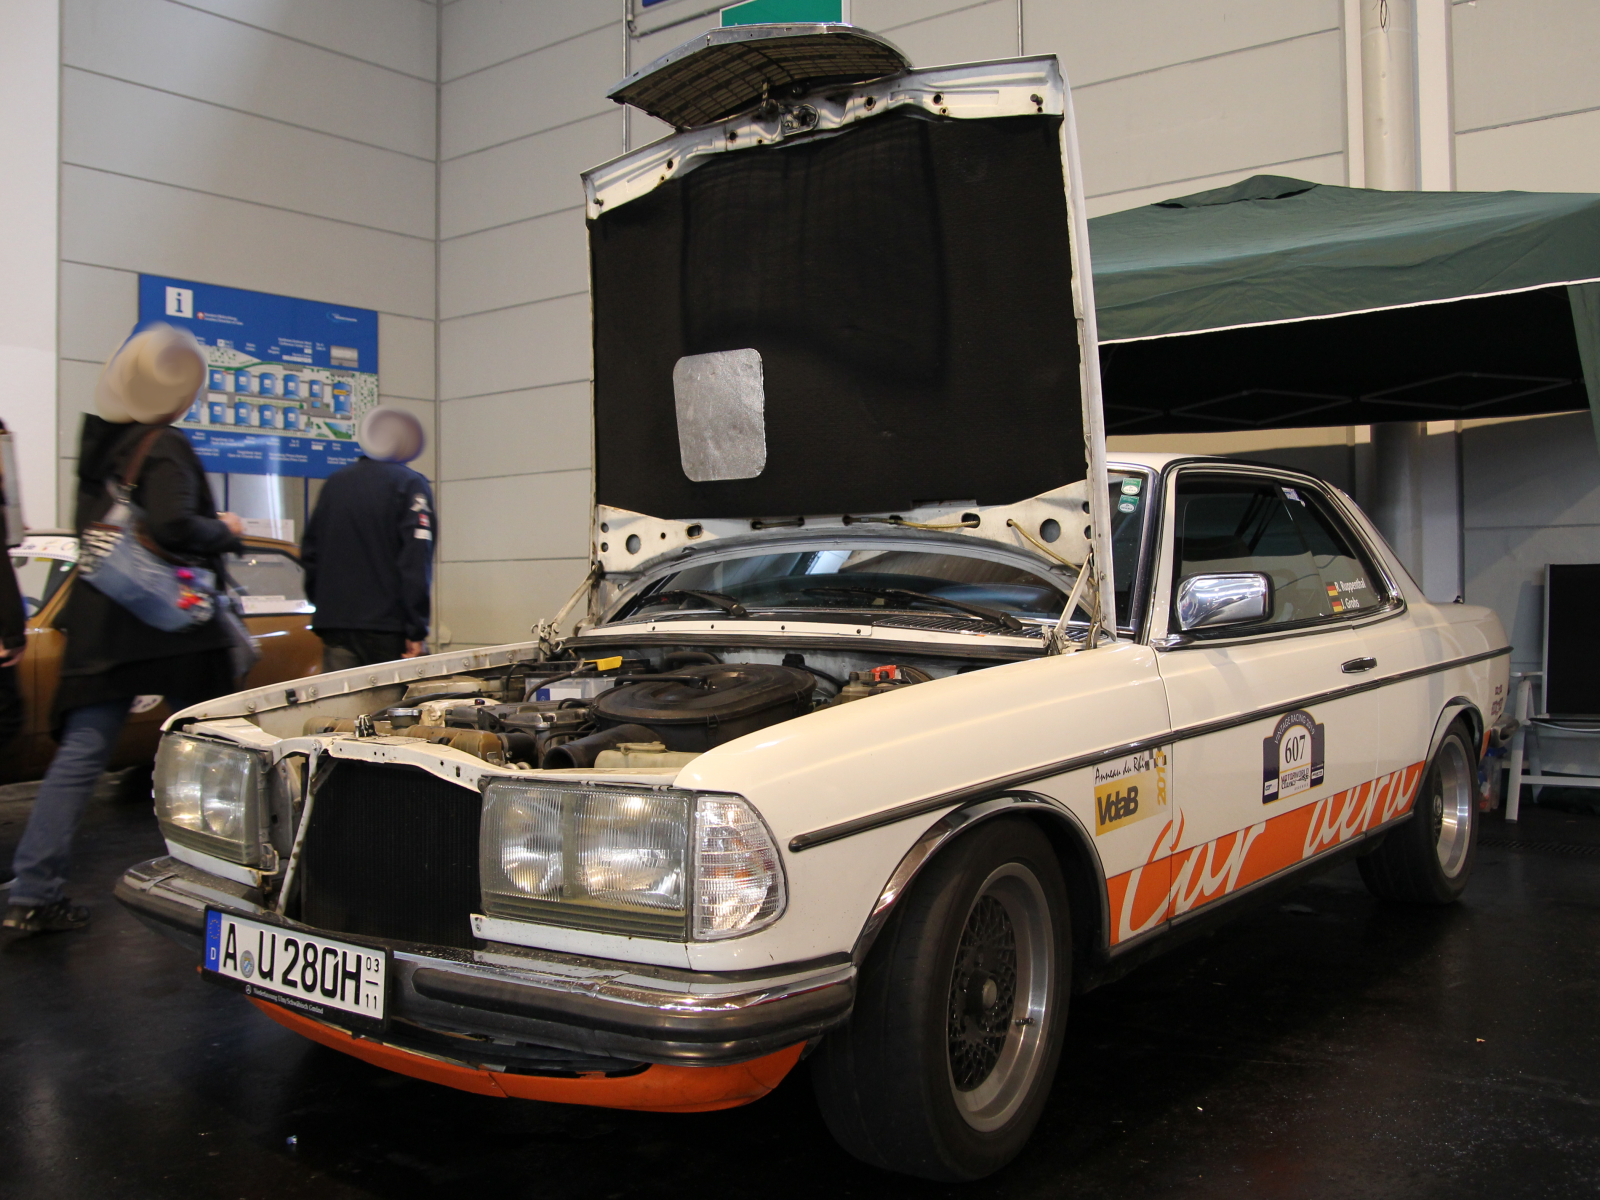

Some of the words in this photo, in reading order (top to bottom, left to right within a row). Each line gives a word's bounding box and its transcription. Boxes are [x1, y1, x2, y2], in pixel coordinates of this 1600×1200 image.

[175, 292, 184, 313] i
[1274, 717, 1291, 745] VINTAGE
[1290, 713, 1306, 724] RACING
[1284, 734, 1306, 764] 607
[1095, 766, 1121, 785] Anneau
[1122, 759, 1132, 776] du
[1155, 749, 1167, 806] 2013
[1097, 785, 1139, 826] VdaB
[210, 946, 217, 961] D
[223, 922, 238, 971] A
[365, 956, 380, 973] 03
[365, 993, 378, 1010] 11
